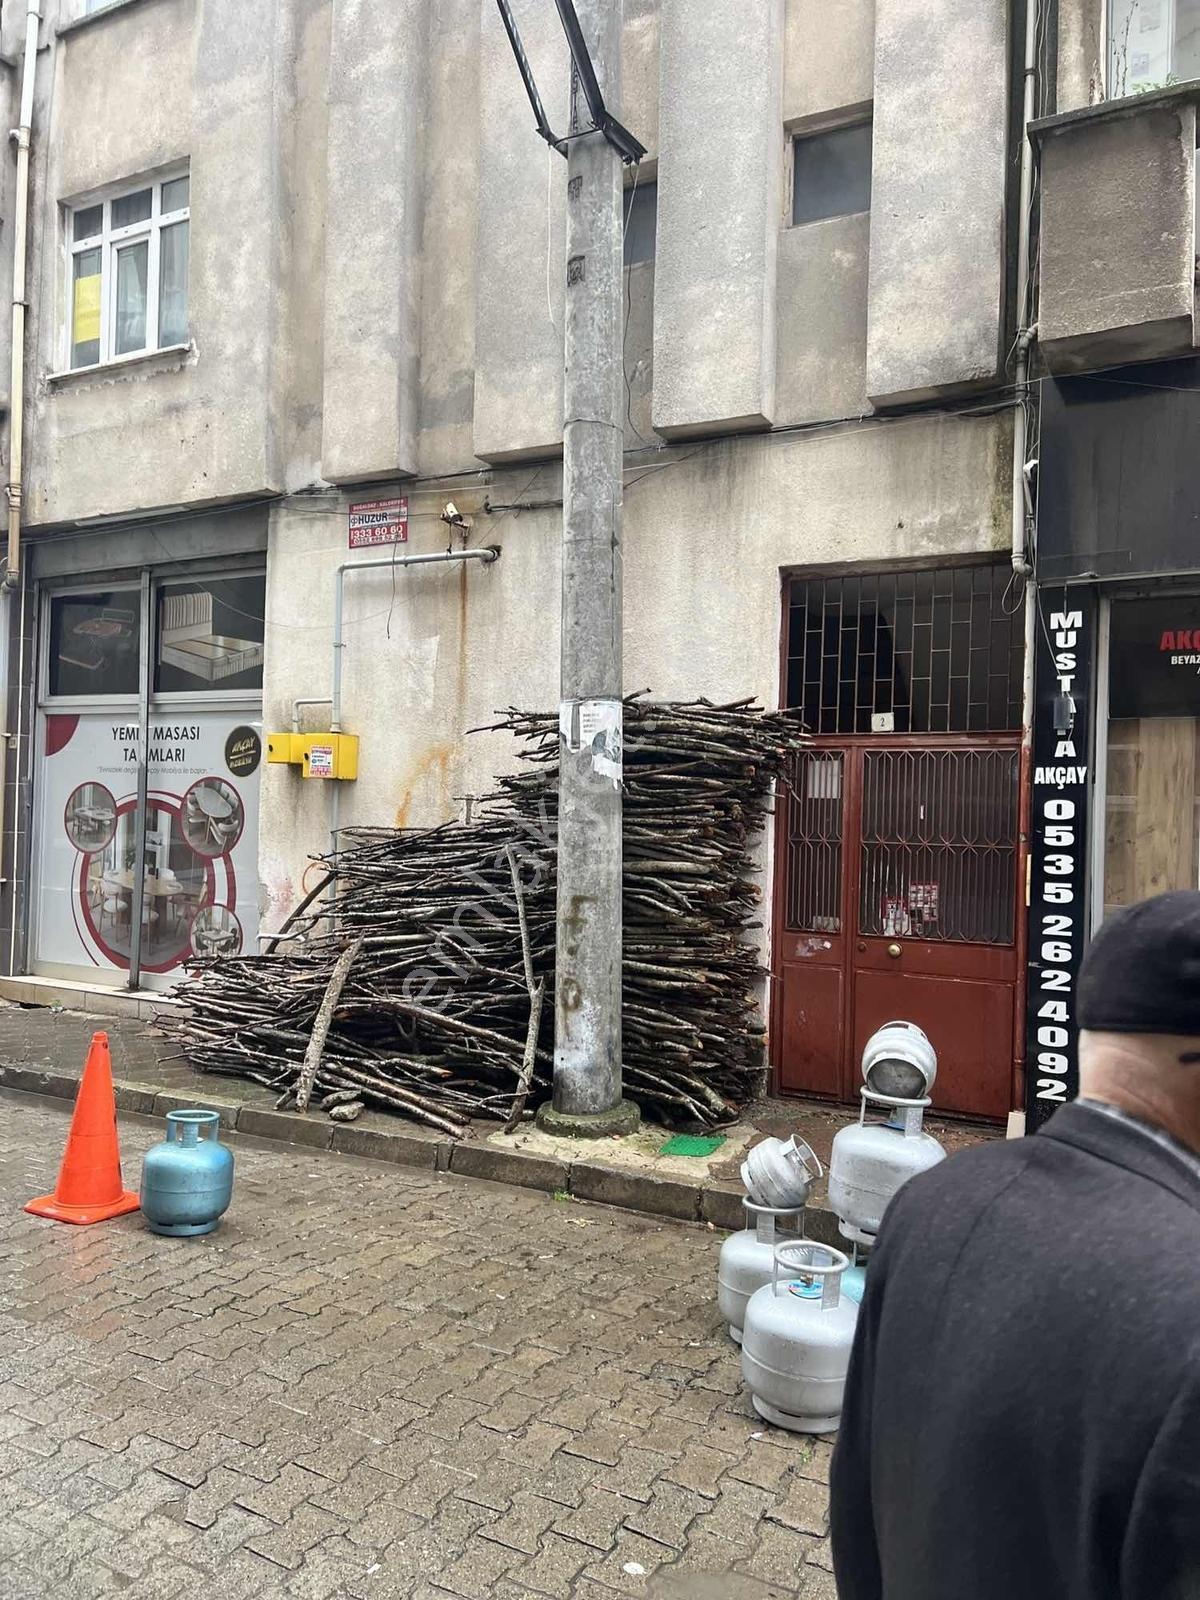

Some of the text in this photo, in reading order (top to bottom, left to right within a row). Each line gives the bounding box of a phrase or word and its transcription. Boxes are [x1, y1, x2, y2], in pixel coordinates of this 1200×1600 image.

[358, 512, 388, 524] HUZUR
[1050, 611, 1083, 758] MUSTA
[153, 726, 200, 740] MASASI
[124, 748, 185, 762] TAMLARI
[1034, 767, 1088, 790] AKÇAY
